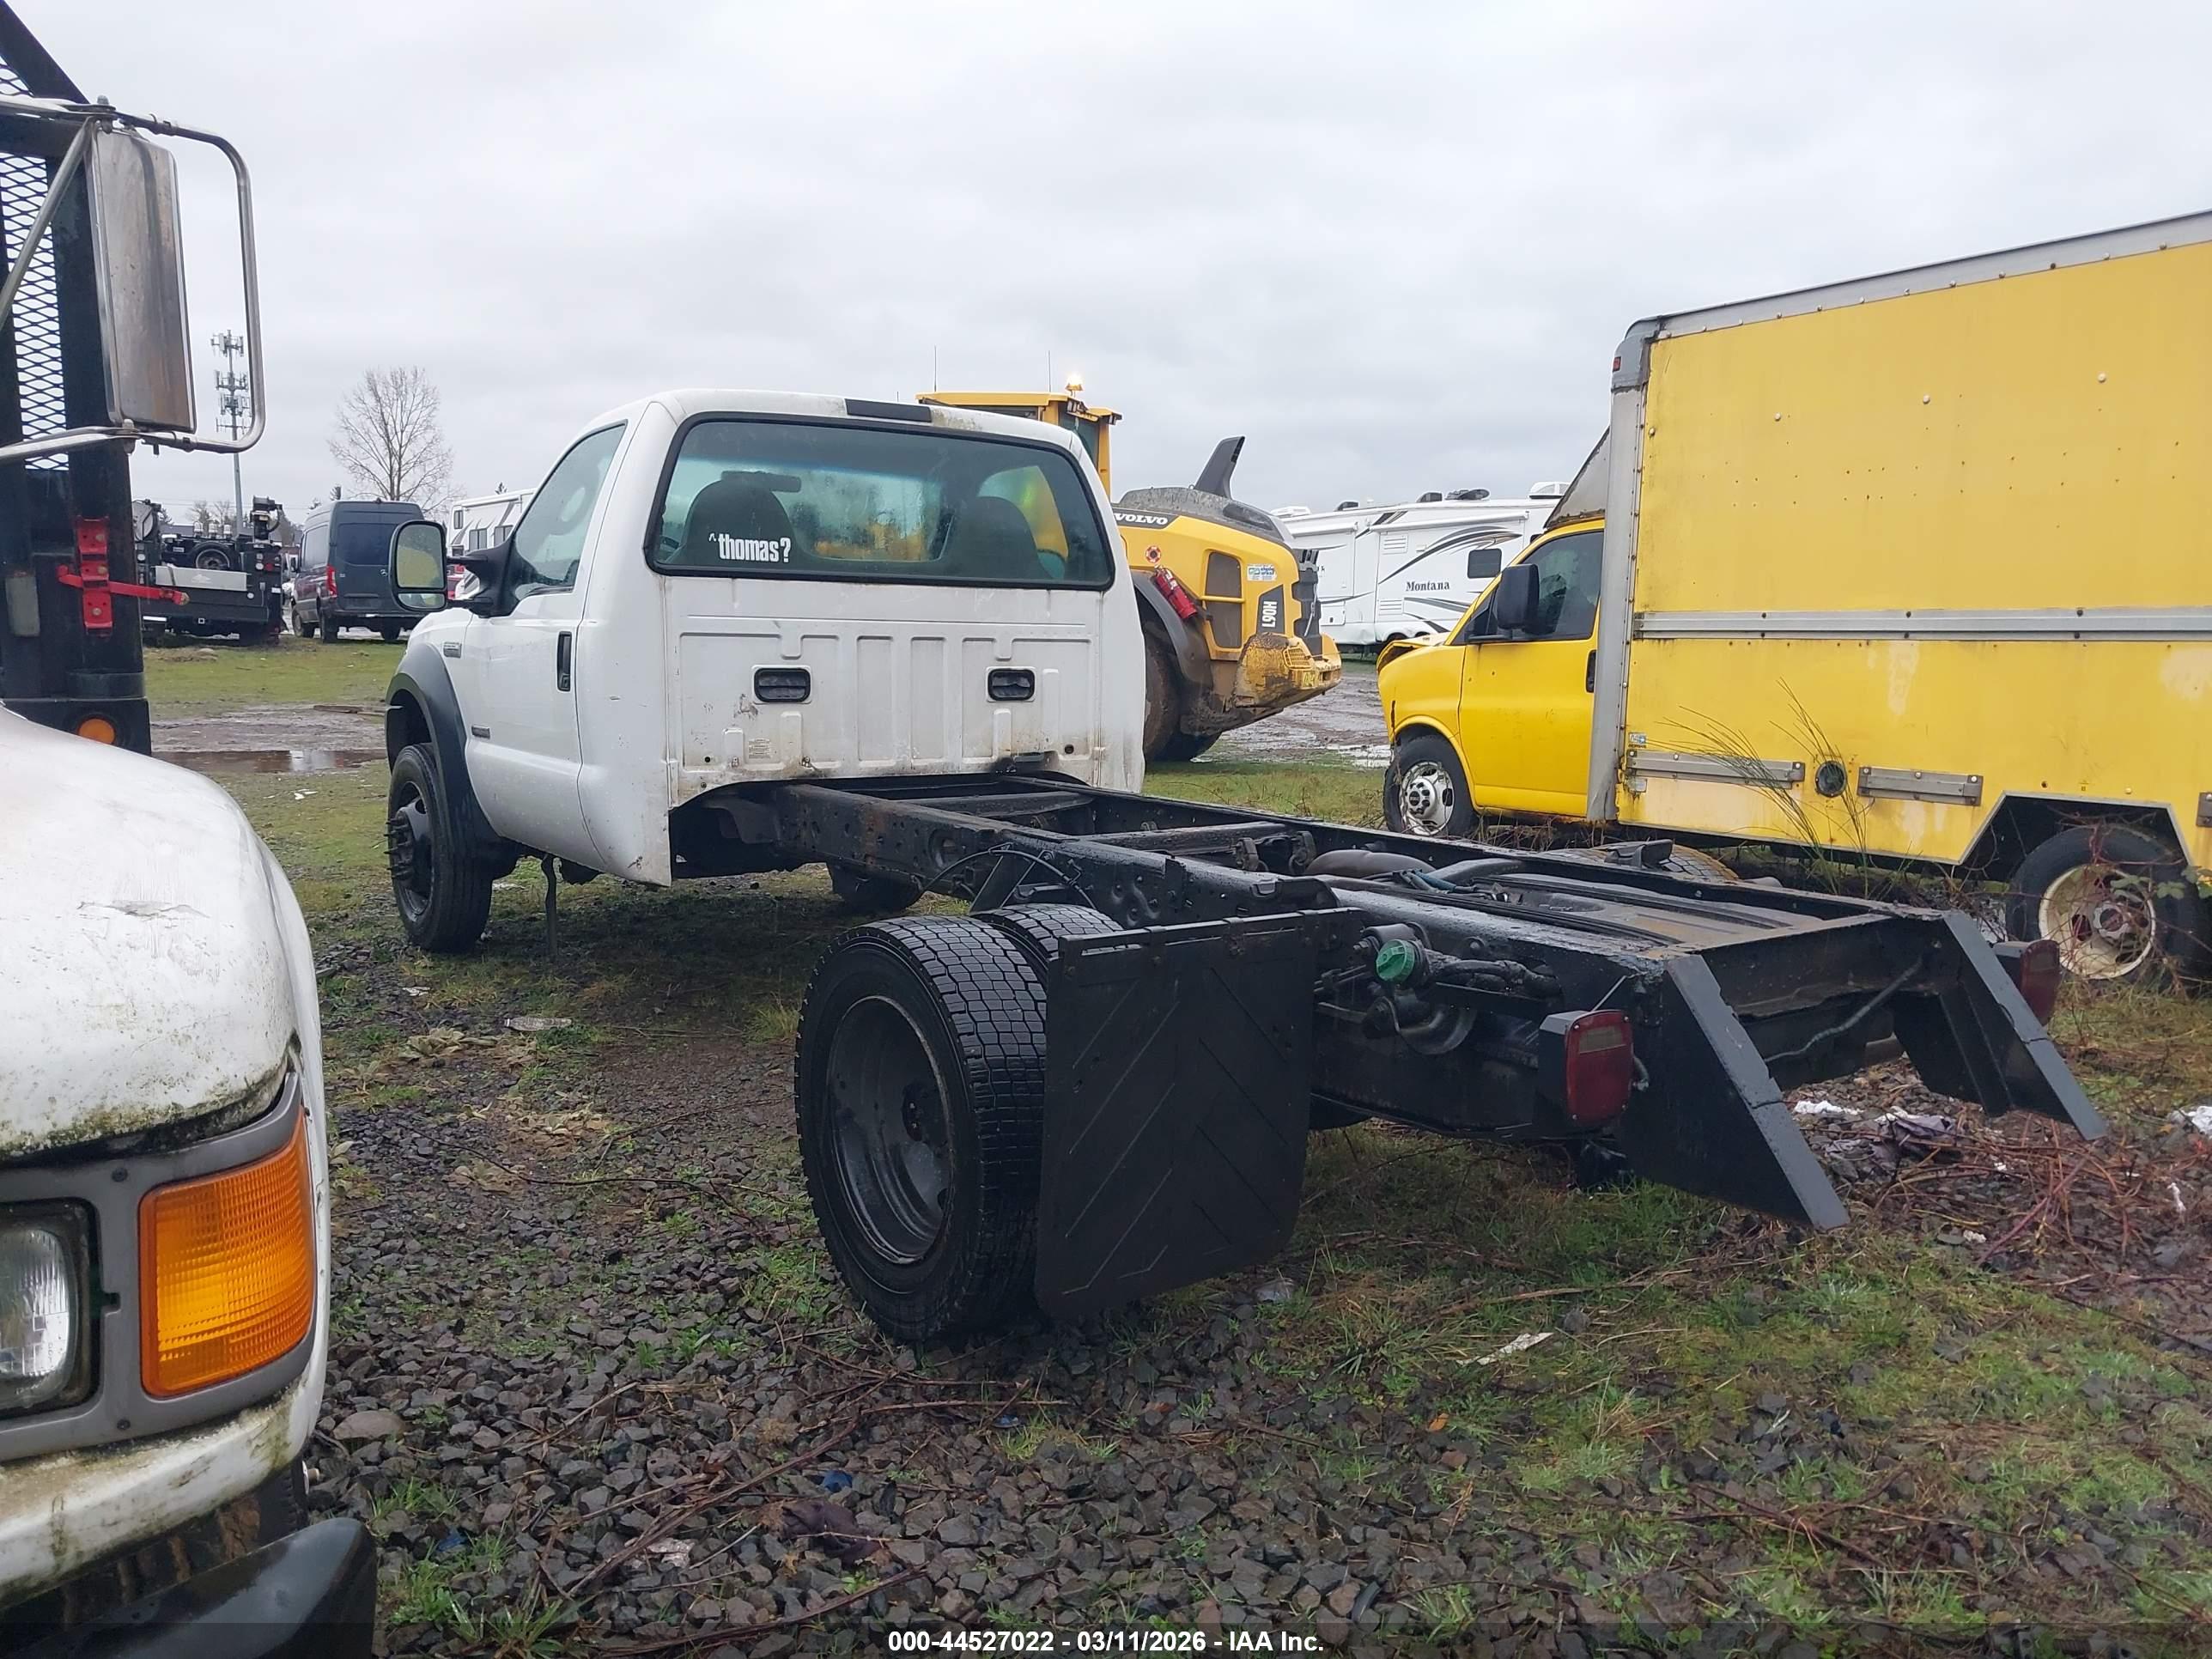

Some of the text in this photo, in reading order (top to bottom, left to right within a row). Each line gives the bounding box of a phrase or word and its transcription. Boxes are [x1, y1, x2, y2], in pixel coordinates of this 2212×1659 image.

[1114, 513, 1169, 526] VOLVO
[718, 533, 792, 562] thomas?
[1405, 580, 1450, 592] Montana
[1261, 600, 1278, 629] L90H
